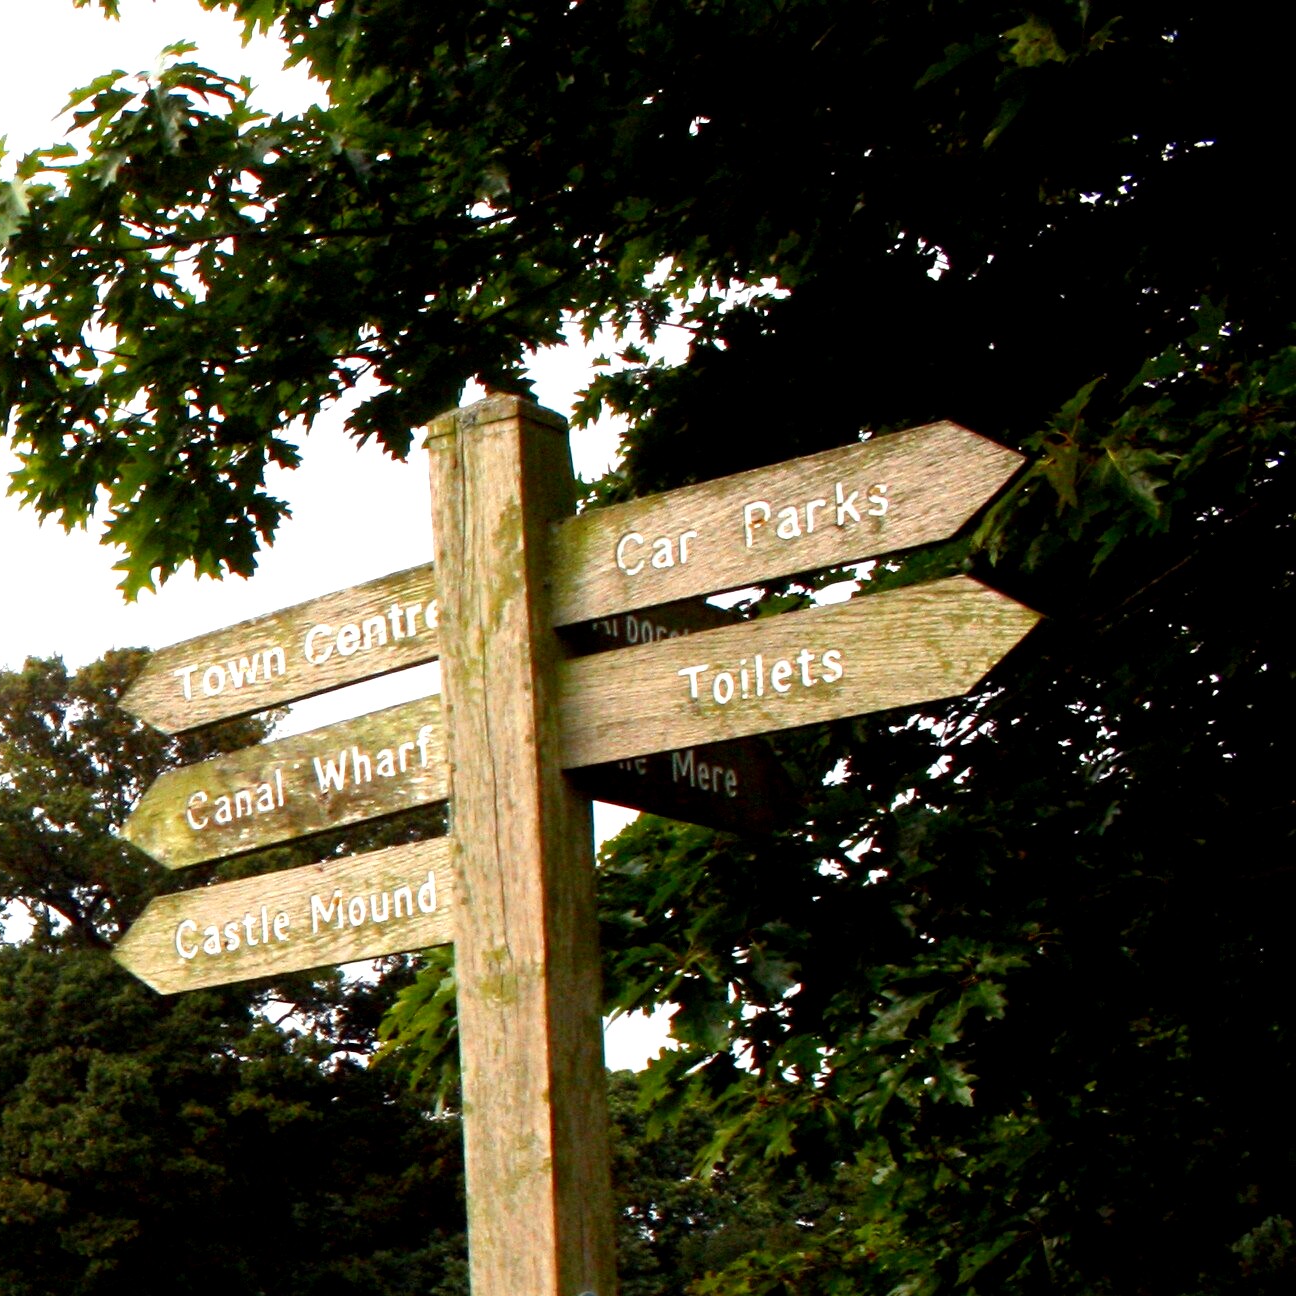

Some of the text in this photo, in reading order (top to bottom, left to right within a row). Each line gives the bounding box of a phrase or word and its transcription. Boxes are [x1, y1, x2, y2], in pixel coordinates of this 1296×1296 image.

[615, 482, 889, 576] Car Parks
[173, 645, 287, 700] Town
[677, 648, 844, 705] Toilets
[185, 724, 434, 830] Canal Wharf
[671, 749, 738, 798] Mere
[175, 870, 438, 960] Castle Mound
